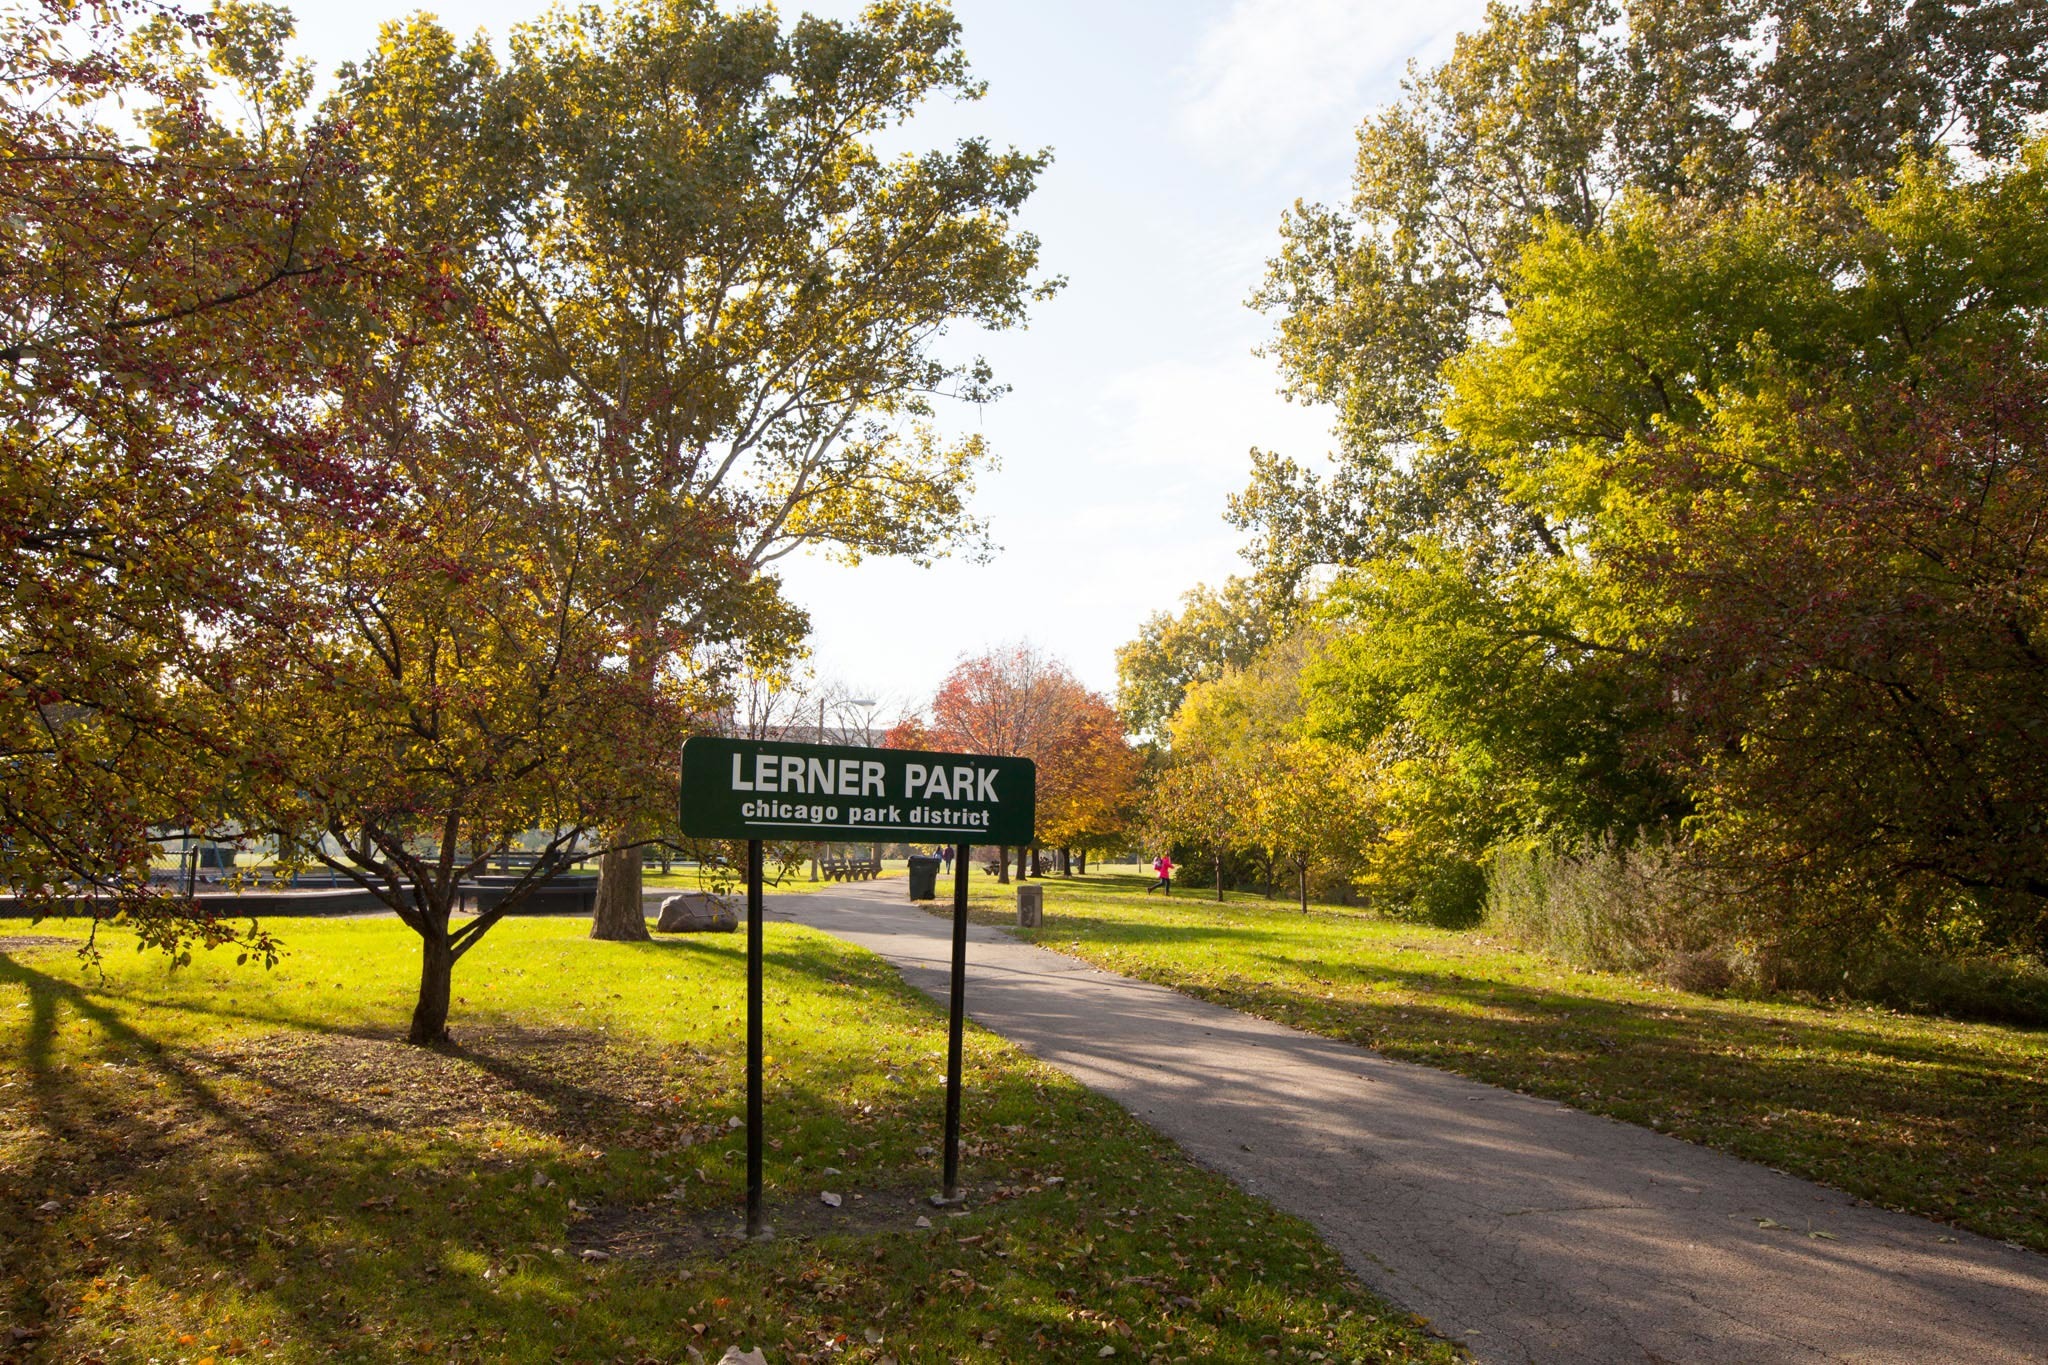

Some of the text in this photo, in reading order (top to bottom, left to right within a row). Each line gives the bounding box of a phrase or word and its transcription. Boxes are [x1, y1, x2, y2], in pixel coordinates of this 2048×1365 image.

[731, 753, 999, 803] LERNER PARK
[741, 800, 990, 827] chicago park district
